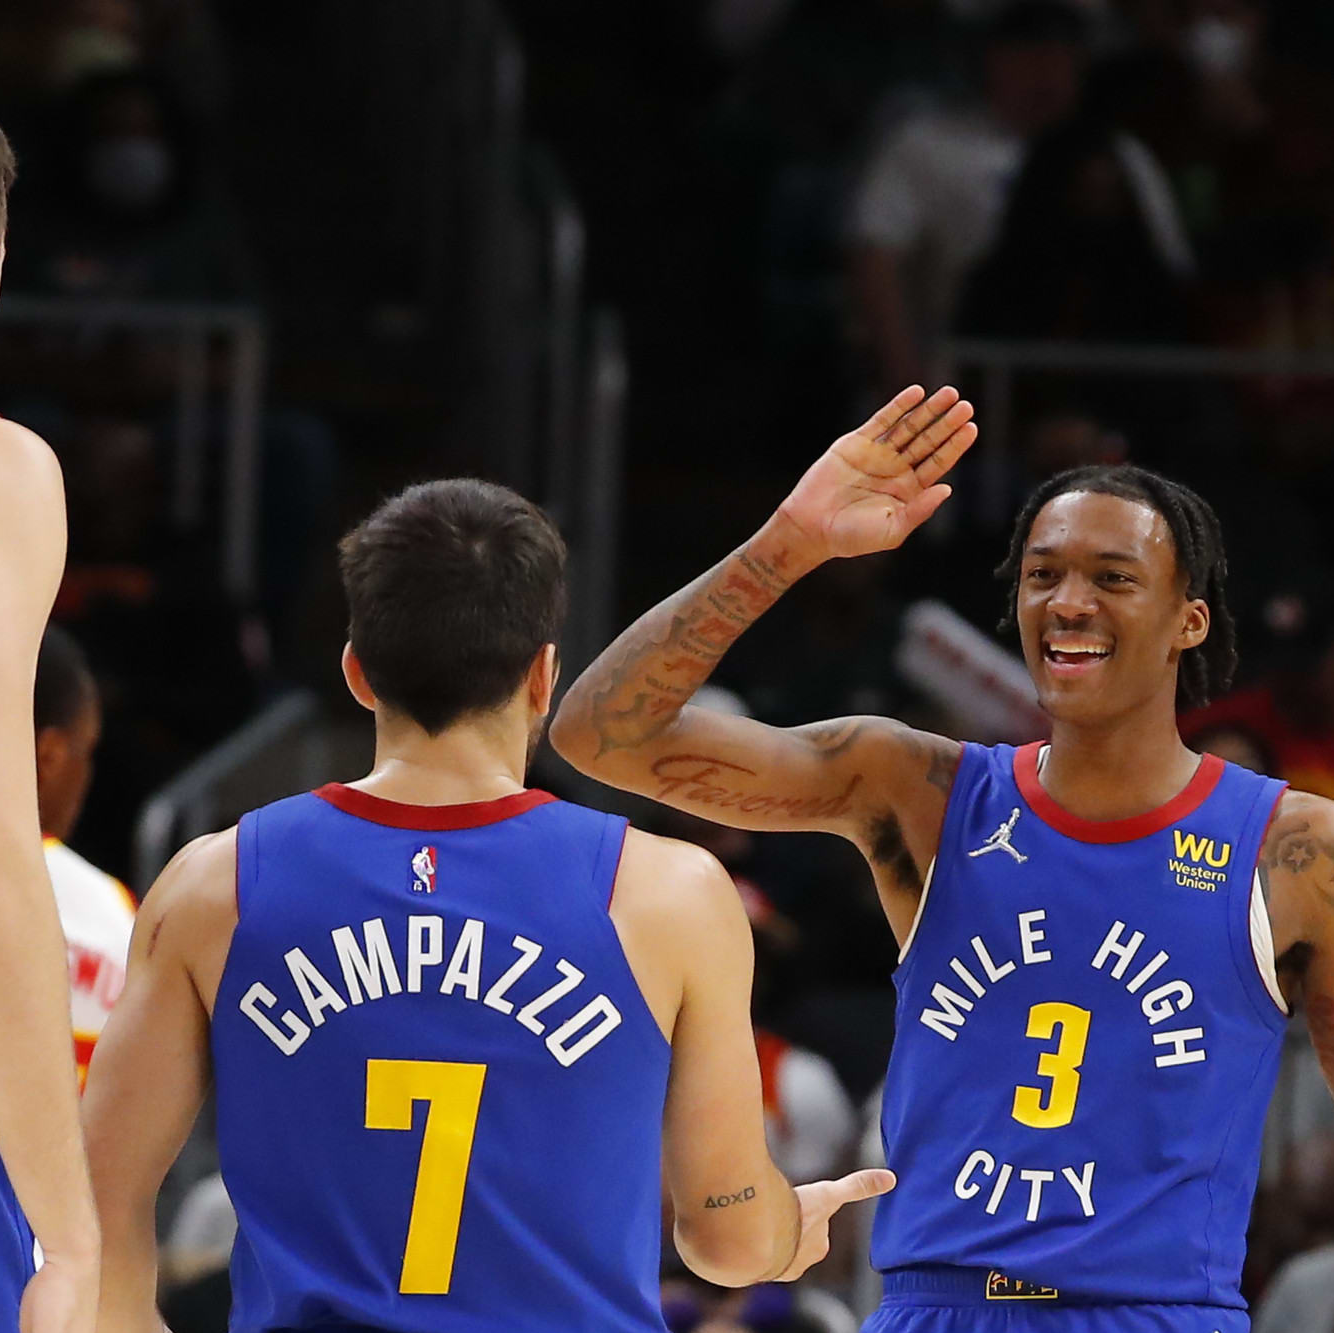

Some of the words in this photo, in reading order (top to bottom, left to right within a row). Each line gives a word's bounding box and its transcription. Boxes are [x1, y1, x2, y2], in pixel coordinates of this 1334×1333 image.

[1168, 859, 1227, 883] Western
[1173, 829, 1231, 868] WU
[1175, 874, 1217, 893] Union
[239, 914, 623, 1068] CAMPAZZO
[919, 909, 1054, 1042] MILE
[1090, 920, 1207, 1069] HIGH
[1012, 1001, 1092, 1129] 3
[364, 1058, 487, 1295] 7
[954, 1150, 1096, 1222] CITY
